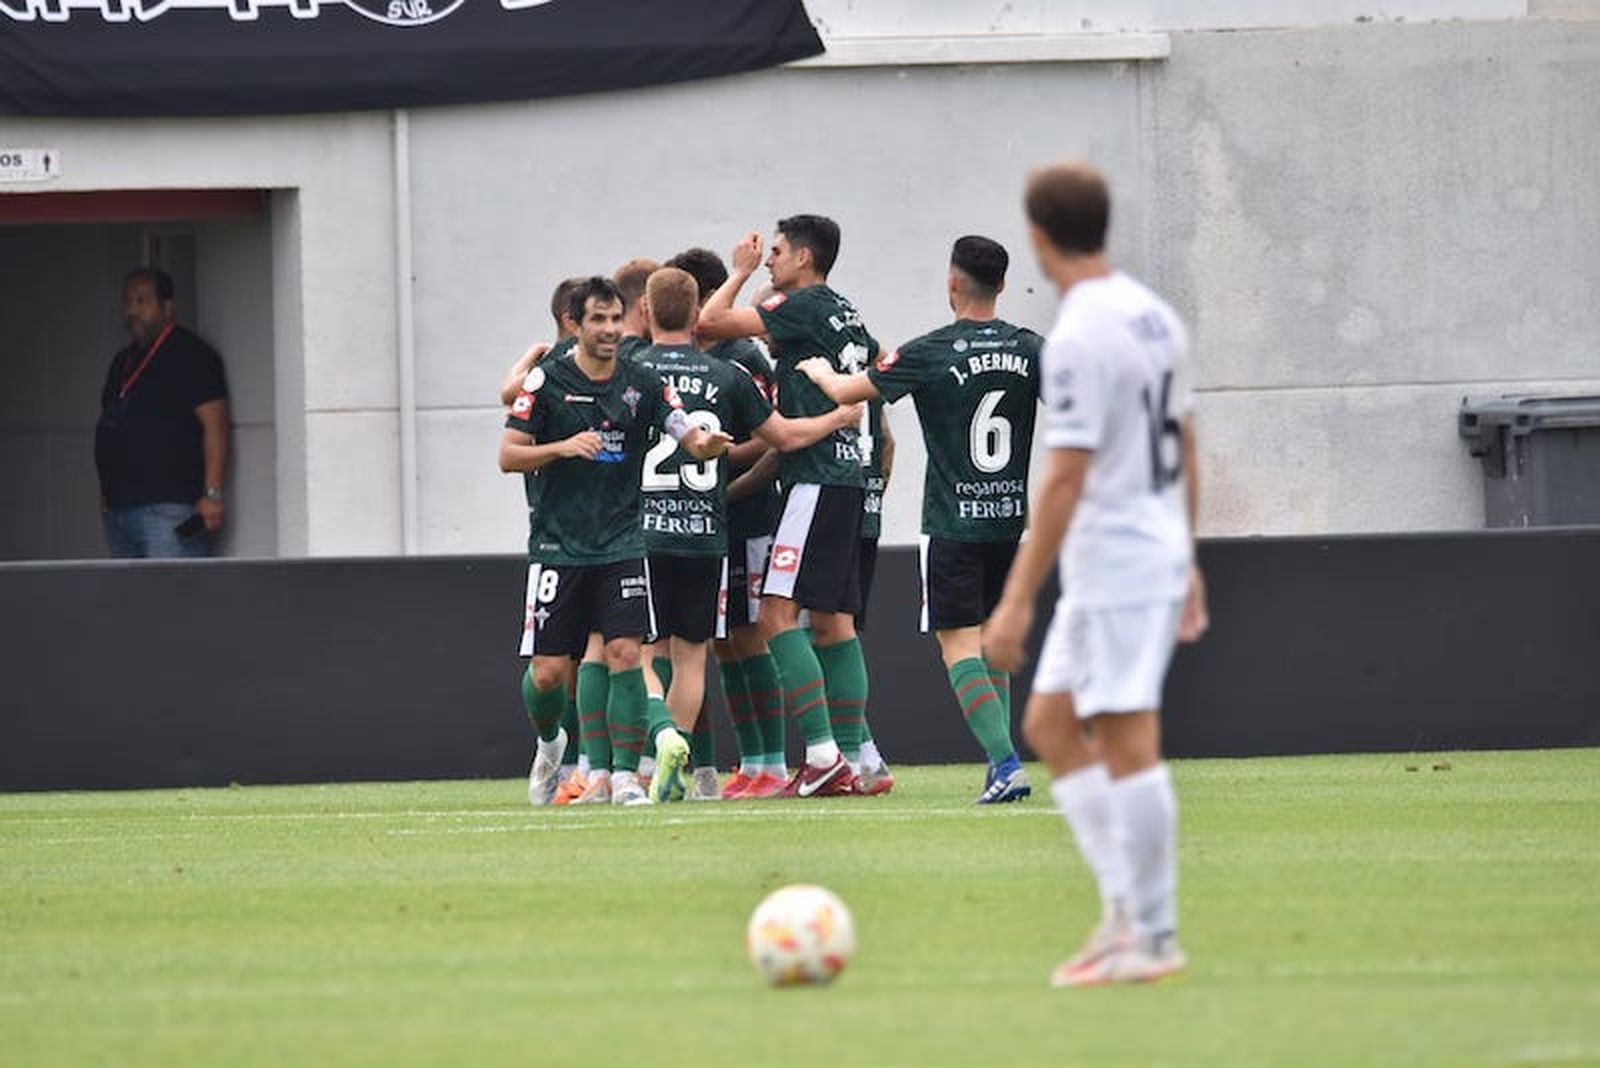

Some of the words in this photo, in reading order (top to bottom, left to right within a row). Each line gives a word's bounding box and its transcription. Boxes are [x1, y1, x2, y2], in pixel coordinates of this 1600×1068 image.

[949, 365, 968, 386] J.
[967, 352, 1030, 378] BERNAL
[704, 383, 720, 404] V.
[969, 389, 1012, 474] 6
[640, 409, 722, 492] 23
[537, 569, 560, 604] 8
